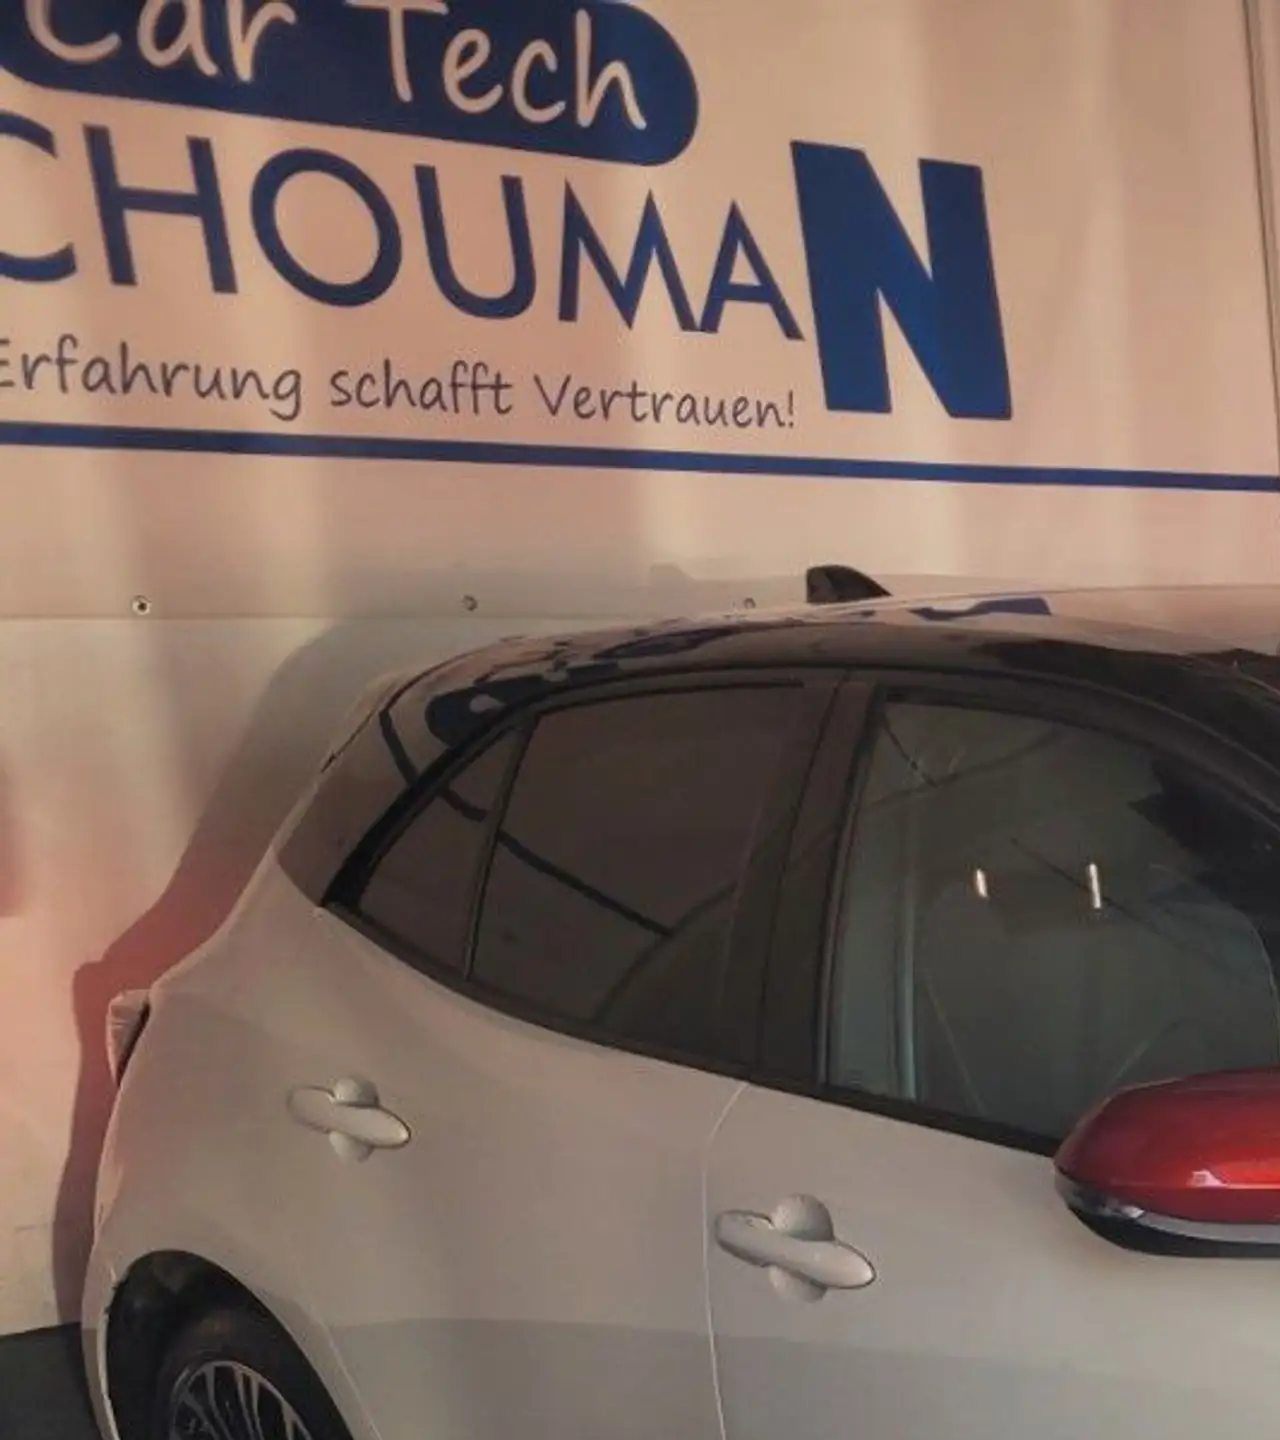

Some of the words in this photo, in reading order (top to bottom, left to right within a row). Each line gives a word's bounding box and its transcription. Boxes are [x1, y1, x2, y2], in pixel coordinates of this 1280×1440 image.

[24, 0, 298, 83] Car
[343, 0, 648, 132] Tech
[329, 358, 514, 416] schafft
[532, 373, 796, 429] Vertrauen!
